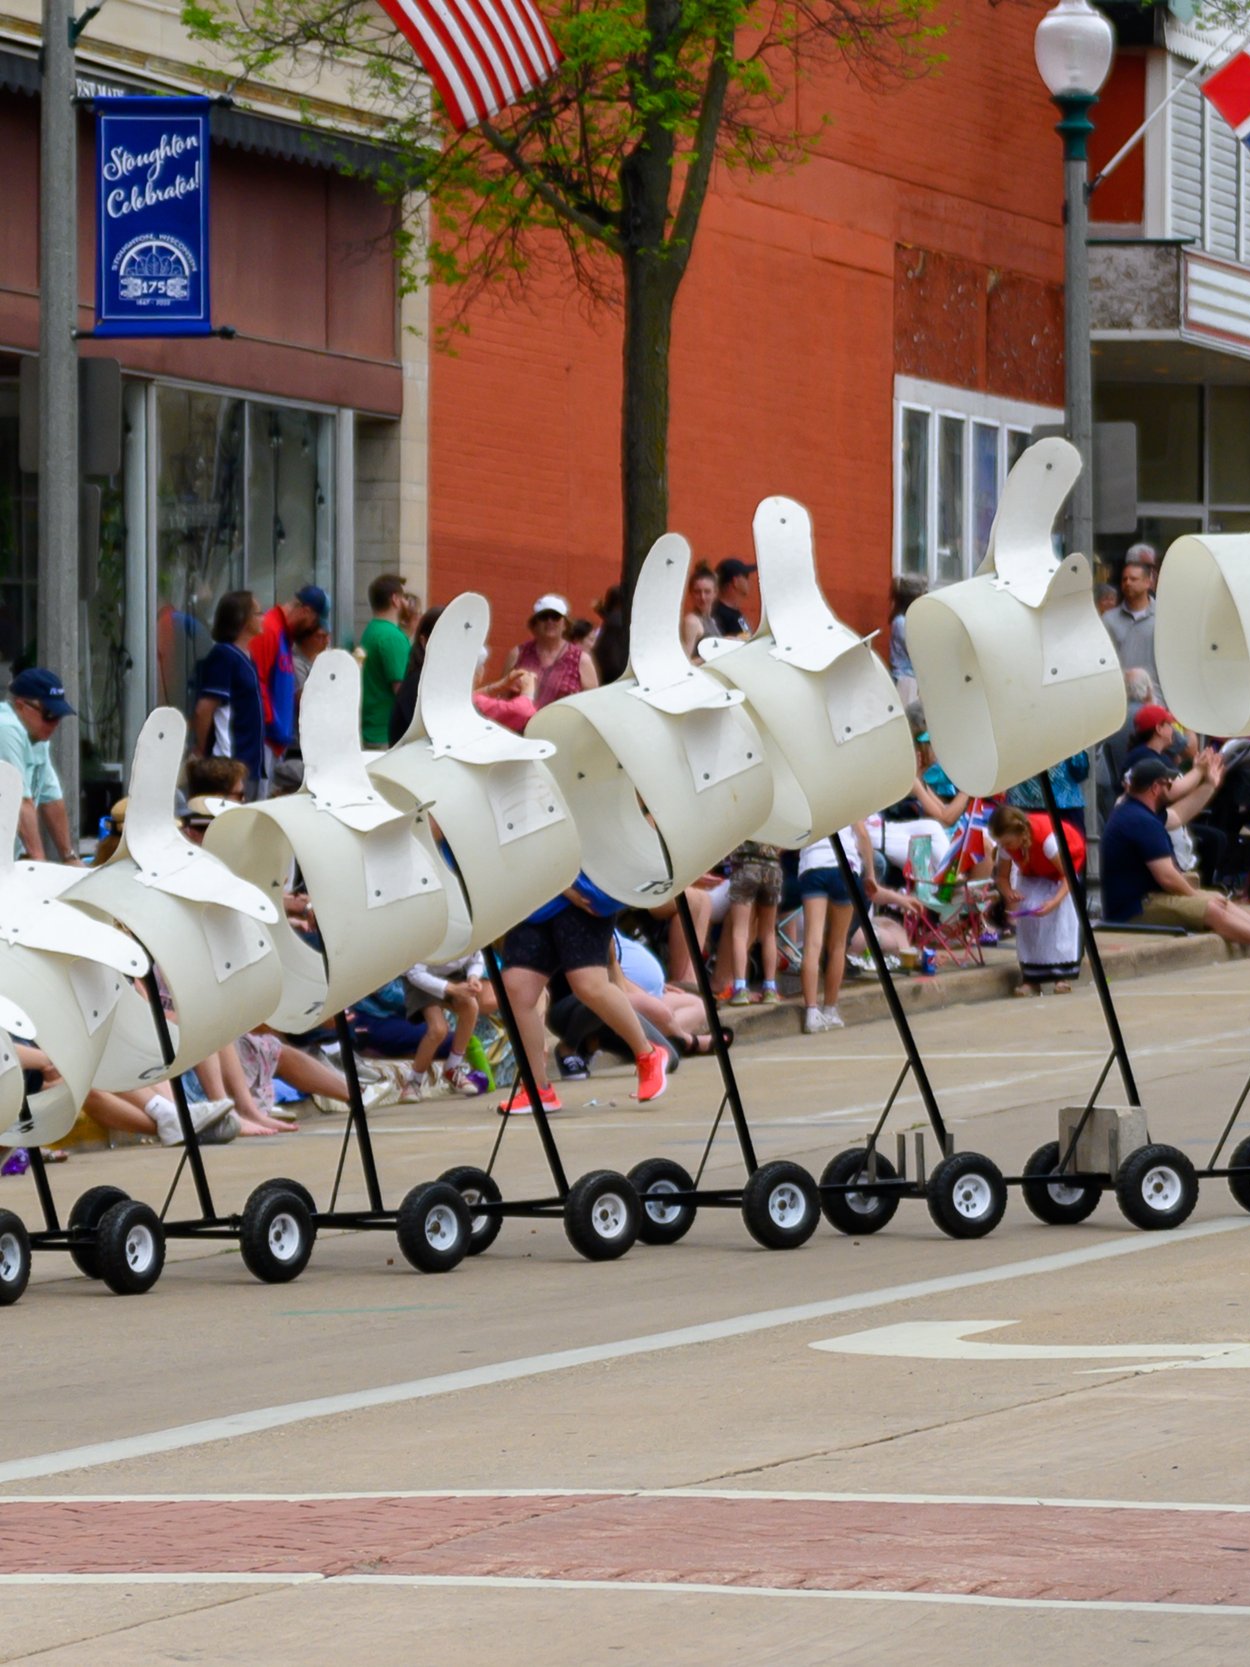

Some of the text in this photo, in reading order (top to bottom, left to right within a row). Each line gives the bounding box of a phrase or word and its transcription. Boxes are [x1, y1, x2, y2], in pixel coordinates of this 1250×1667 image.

[103, 134, 198, 181] Stoughton
[107, 160, 199, 218] Celebrates!
[142, 281, 166, 294] 175
